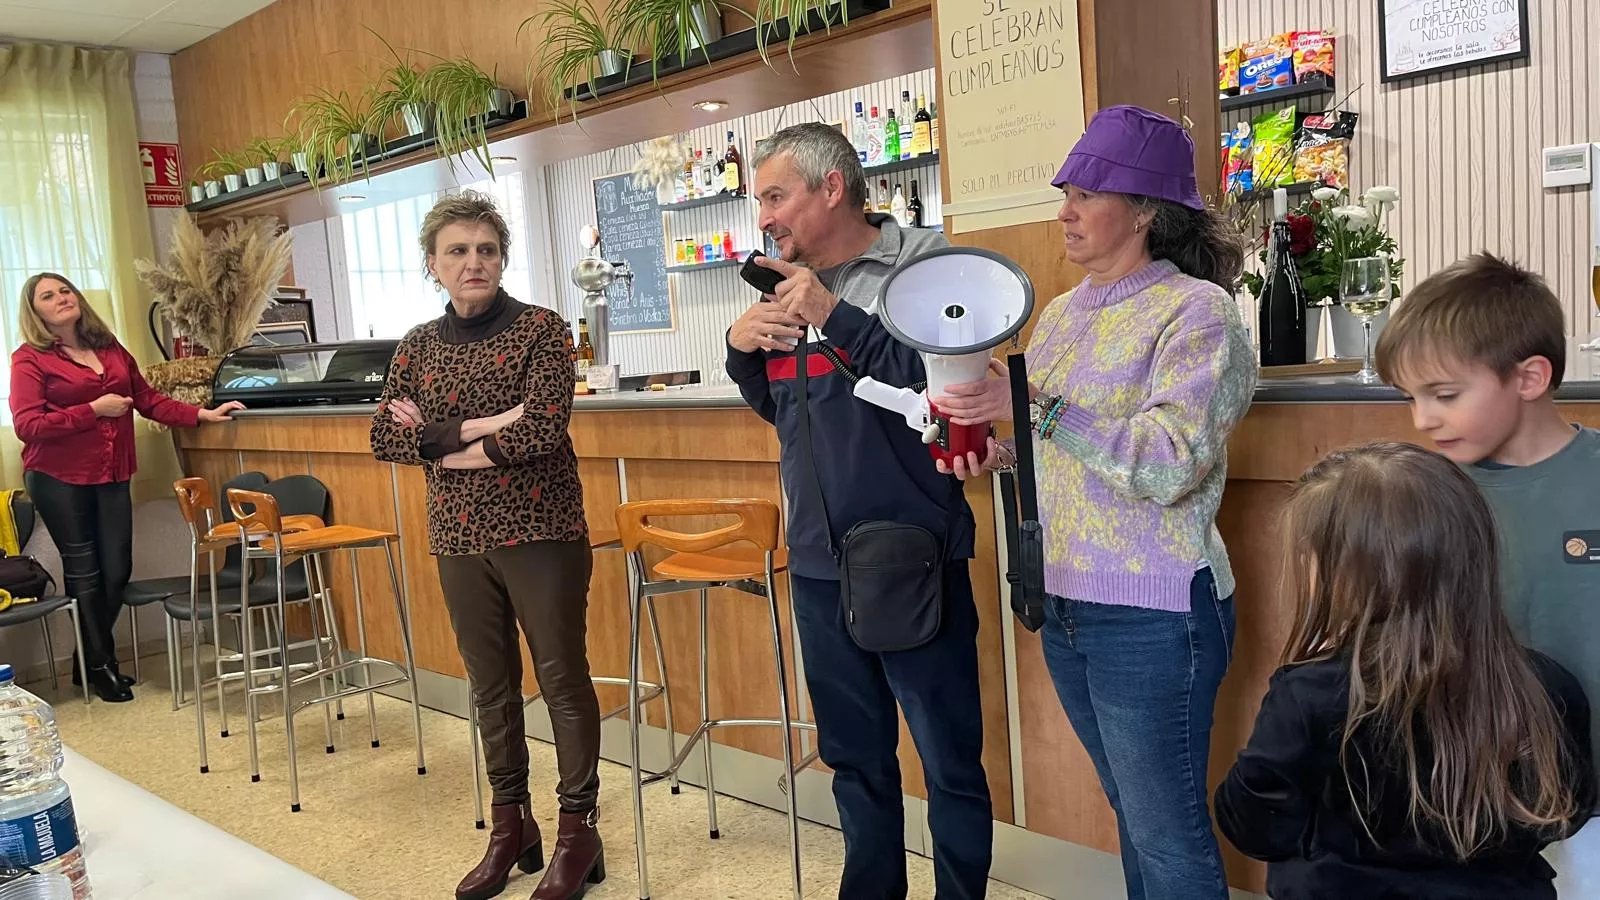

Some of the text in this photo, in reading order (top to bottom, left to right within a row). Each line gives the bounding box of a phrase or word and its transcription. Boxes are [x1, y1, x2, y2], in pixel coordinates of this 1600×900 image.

[1492, 0, 1515, 15] CON
[951, 3, 1064, 59] CELEBRAN
[1422, 18, 1487, 42] NOSOTROS
[949, 38, 1065, 97] CUMPLEAÑOS
[960, 177, 985, 195] SOLO
[147, 193, 181, 202] XTINTOR
[41, 846, 57, 861] LA
